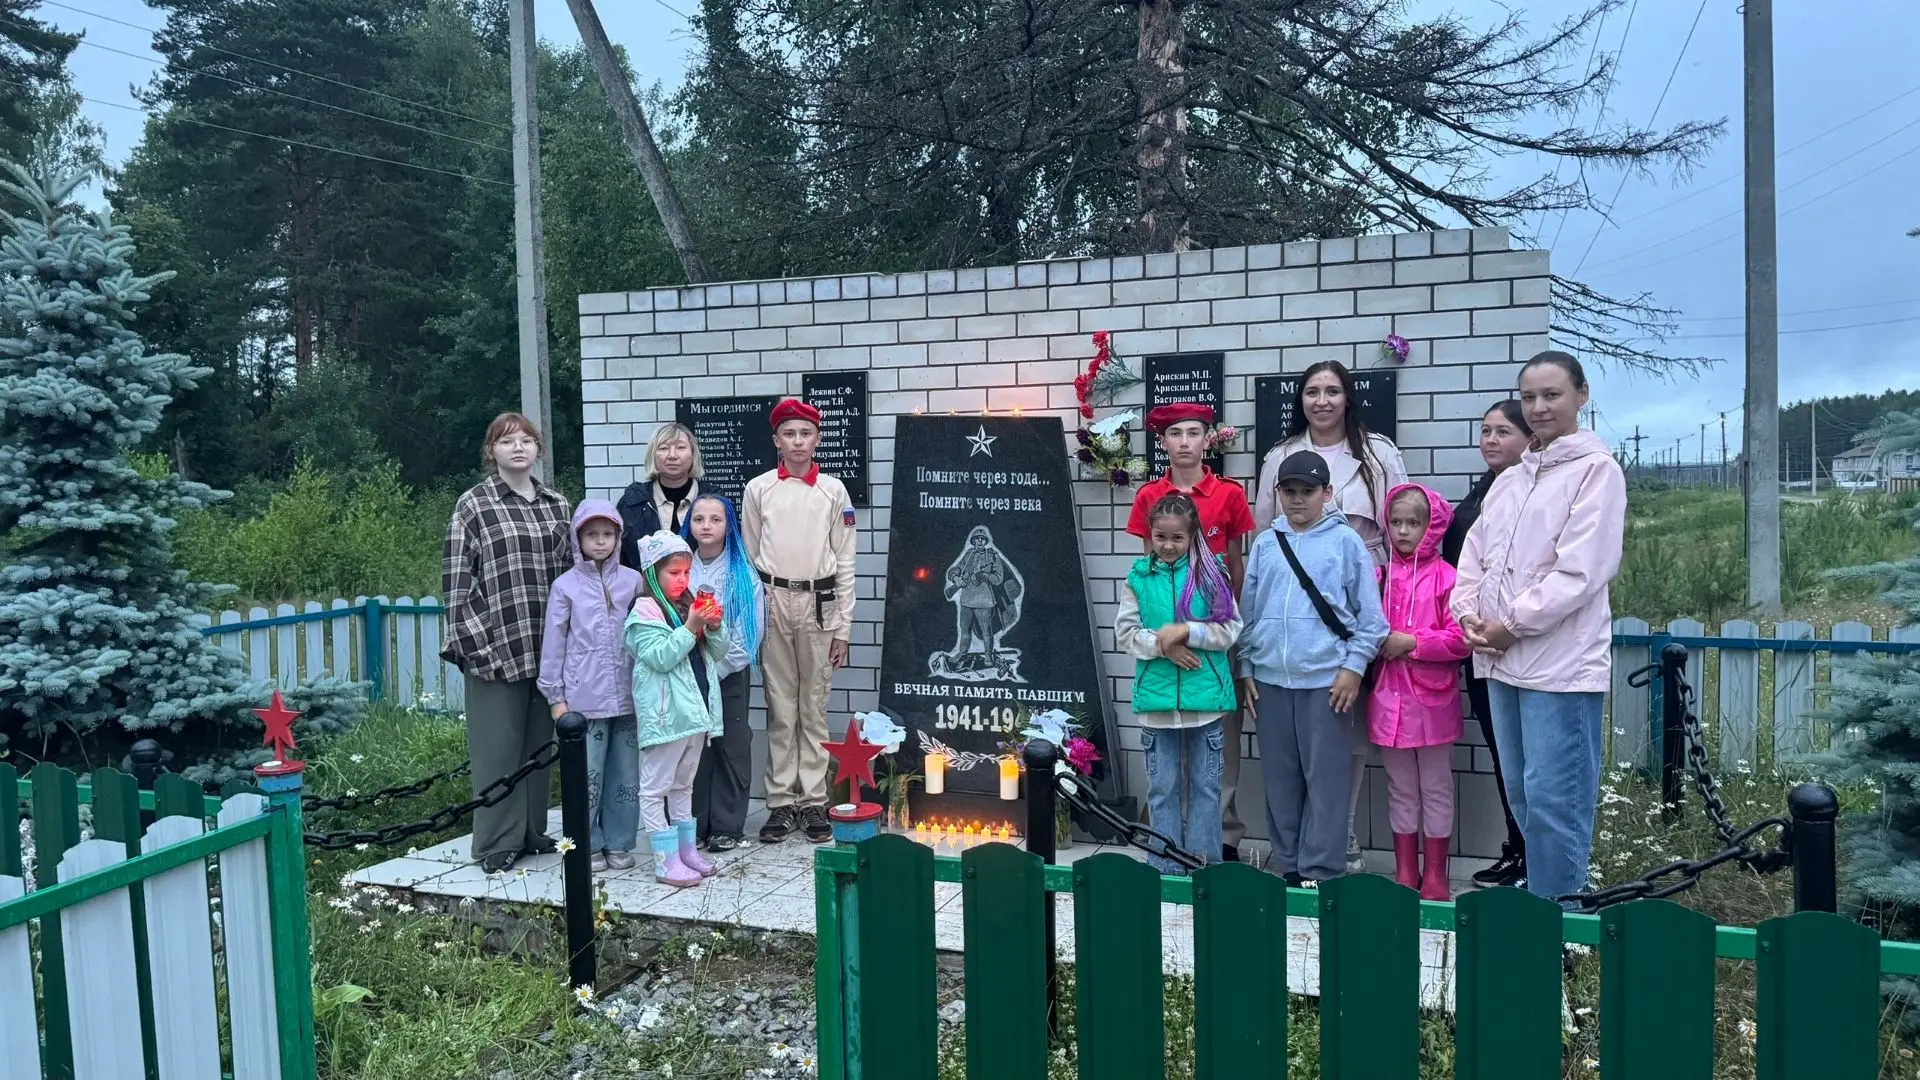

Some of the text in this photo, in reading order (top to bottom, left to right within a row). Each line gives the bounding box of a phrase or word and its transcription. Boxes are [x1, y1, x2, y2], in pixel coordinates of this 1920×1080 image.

[1153, 370, 1212, 383] Арискин М.П.
[808, 386, 854, 396] Лежнин С.Ф.
[1153, 382, 1211, 395] Арискин Н.П.
[809, 398, 830, 408] Серов
[1154, 392, 1217, 404] Бастраков В.Ф.
[690, 402, 710, 414] Мы
[916, 466, 1051, 489] Помните через года...
[919, 491, 1042, 515] Помните через века
[894, 683, 1085, 704] ВЕЧНАЯ ПАМЯТЬ ПАВШИМ
